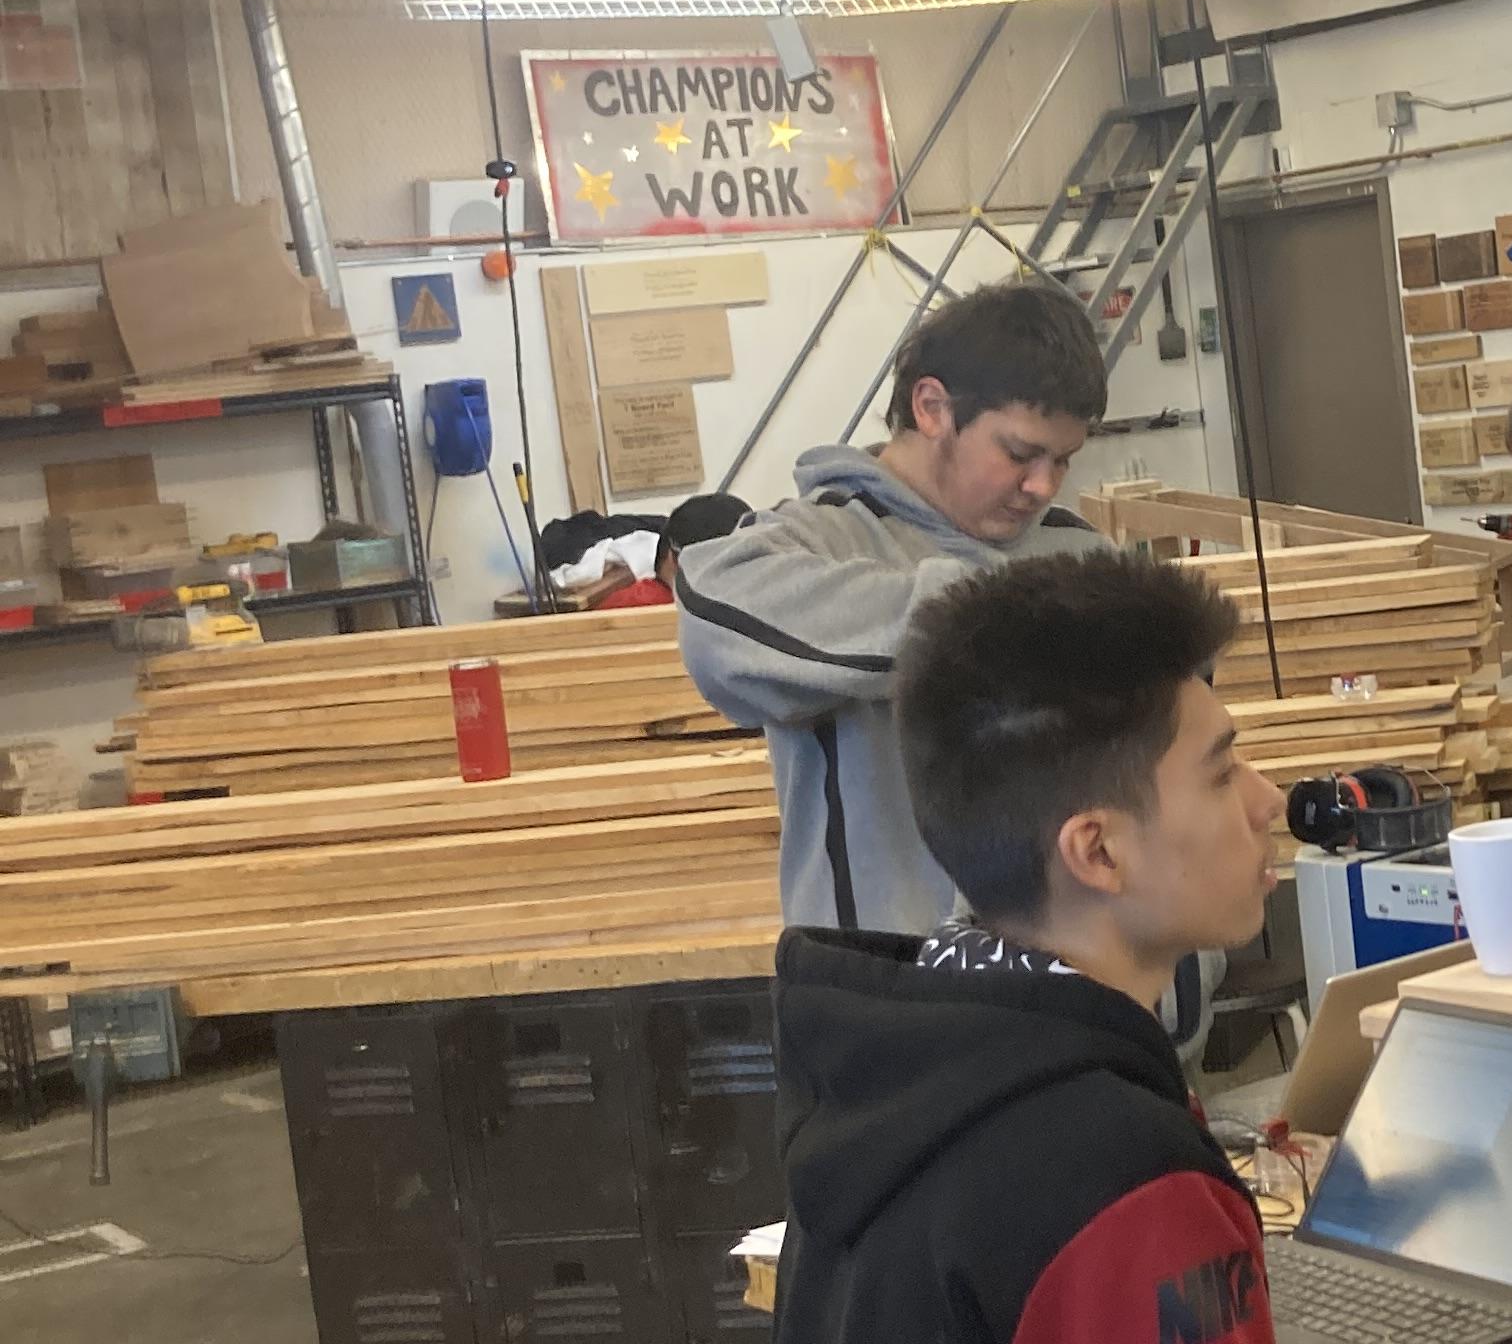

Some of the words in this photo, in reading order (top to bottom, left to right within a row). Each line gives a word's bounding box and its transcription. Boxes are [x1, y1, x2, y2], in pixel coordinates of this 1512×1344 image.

[584, 65, 835, 117] CHAMPIONS
[703, 118, 754, 160] AT
[646, 166, 810, 218] WORK
